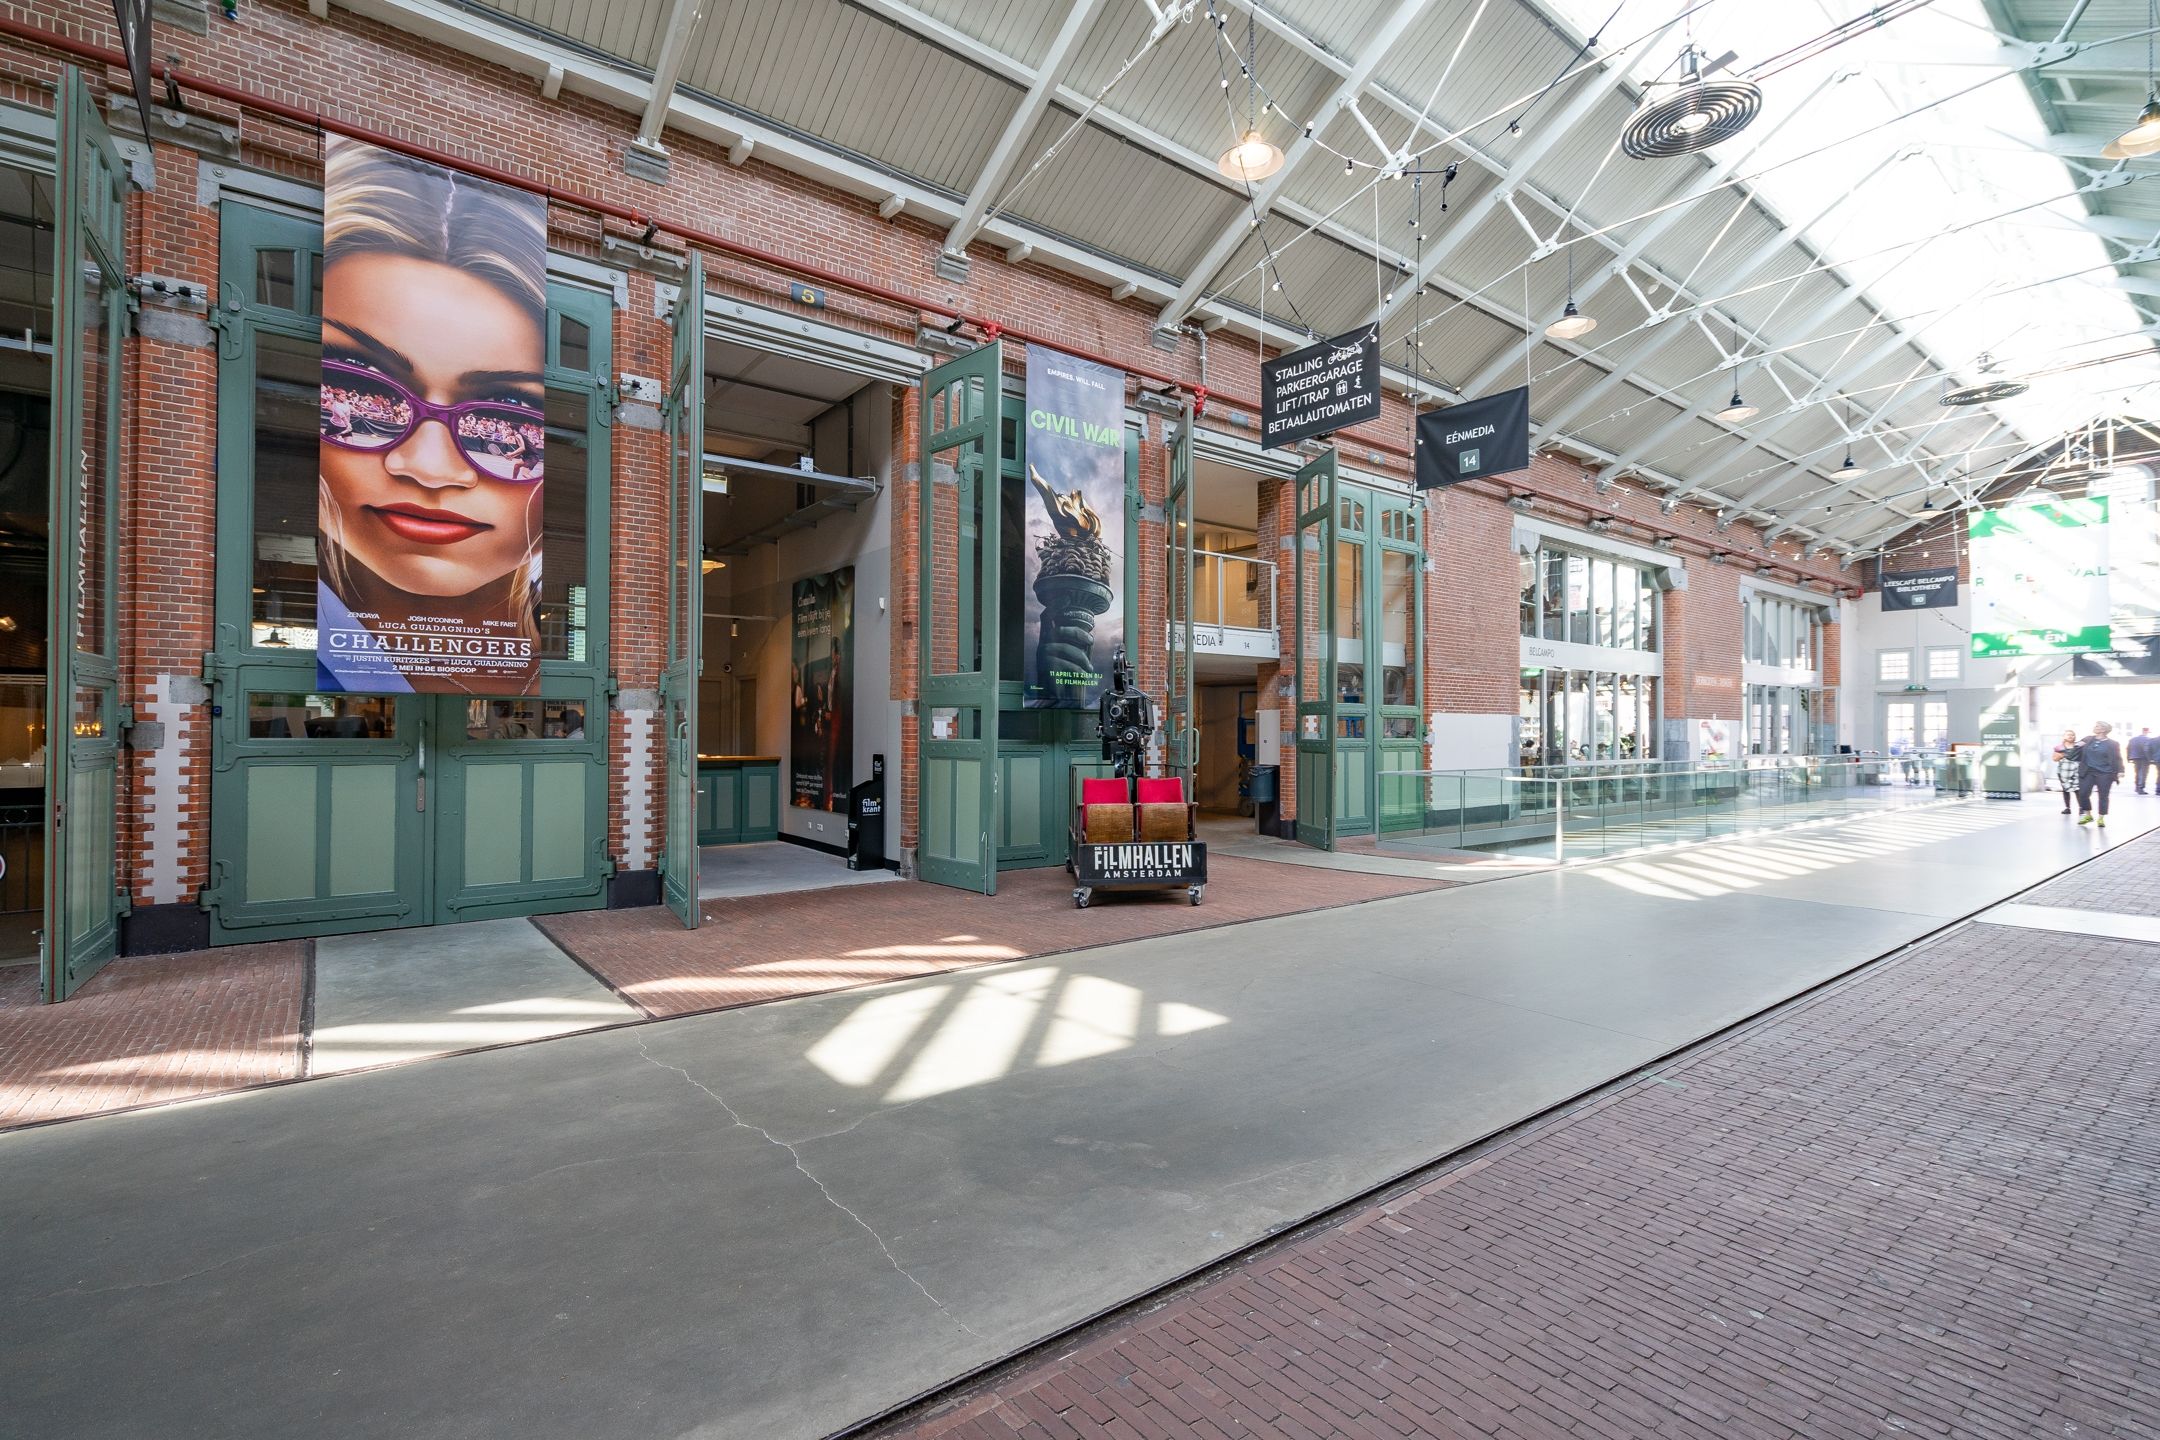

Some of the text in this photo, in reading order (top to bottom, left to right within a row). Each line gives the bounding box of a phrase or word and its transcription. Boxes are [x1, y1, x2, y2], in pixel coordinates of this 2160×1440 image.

[801, 289, 815, 304] 5
[1047, 368, 1075, 381] EMPIRES.
[1275, 356, 1323, 382] STALLING
[1276, 359, 1363, 398] PARKEERGARAGE
[1276, 387, 1330, 414] LIFT/TRAP
[1268, 392, 1372, 434] BETAALAUTOMATEN
[1030, 409, 1079, 438] CIVIL
[1082, 421, 1120, 448] WAR
[1445, 424, 1496, 445] EÉNMEDIA
[1373, 454, 1380, 464] 2
[1463, 455, 1477, 467] 14
[76, 449, 88, 638] FILMHALLEN
[1917, 575, 1955, 585] BELCAMPO
[1896, 583, 1942, 593] BIBLIOTHEEK
[347, 612, 380, 620] ZENDAYA
[427, 616, 464, 625] O'CONNOR
[378, 622, 491, 635] LUCA GUADAGNINO'S
[482, 619, 498, 627] MIKE
[329, 633, 532, 656] CHALLENGERS
[1529, 646, 1555, 658] BELCAMPO
[352, 654, 382, 663] JUSTIN
[384, 656, 430, 664] KURITZKES
[474, 660, 529, 668] GUADAGNINO
[862, 798, 877, 806] film
[862, 805, 881, 813] krant
[1094, 844, 1193, 870] FILMHALLEN
[1104, 869, 1182, 879] AMSTERDAM
